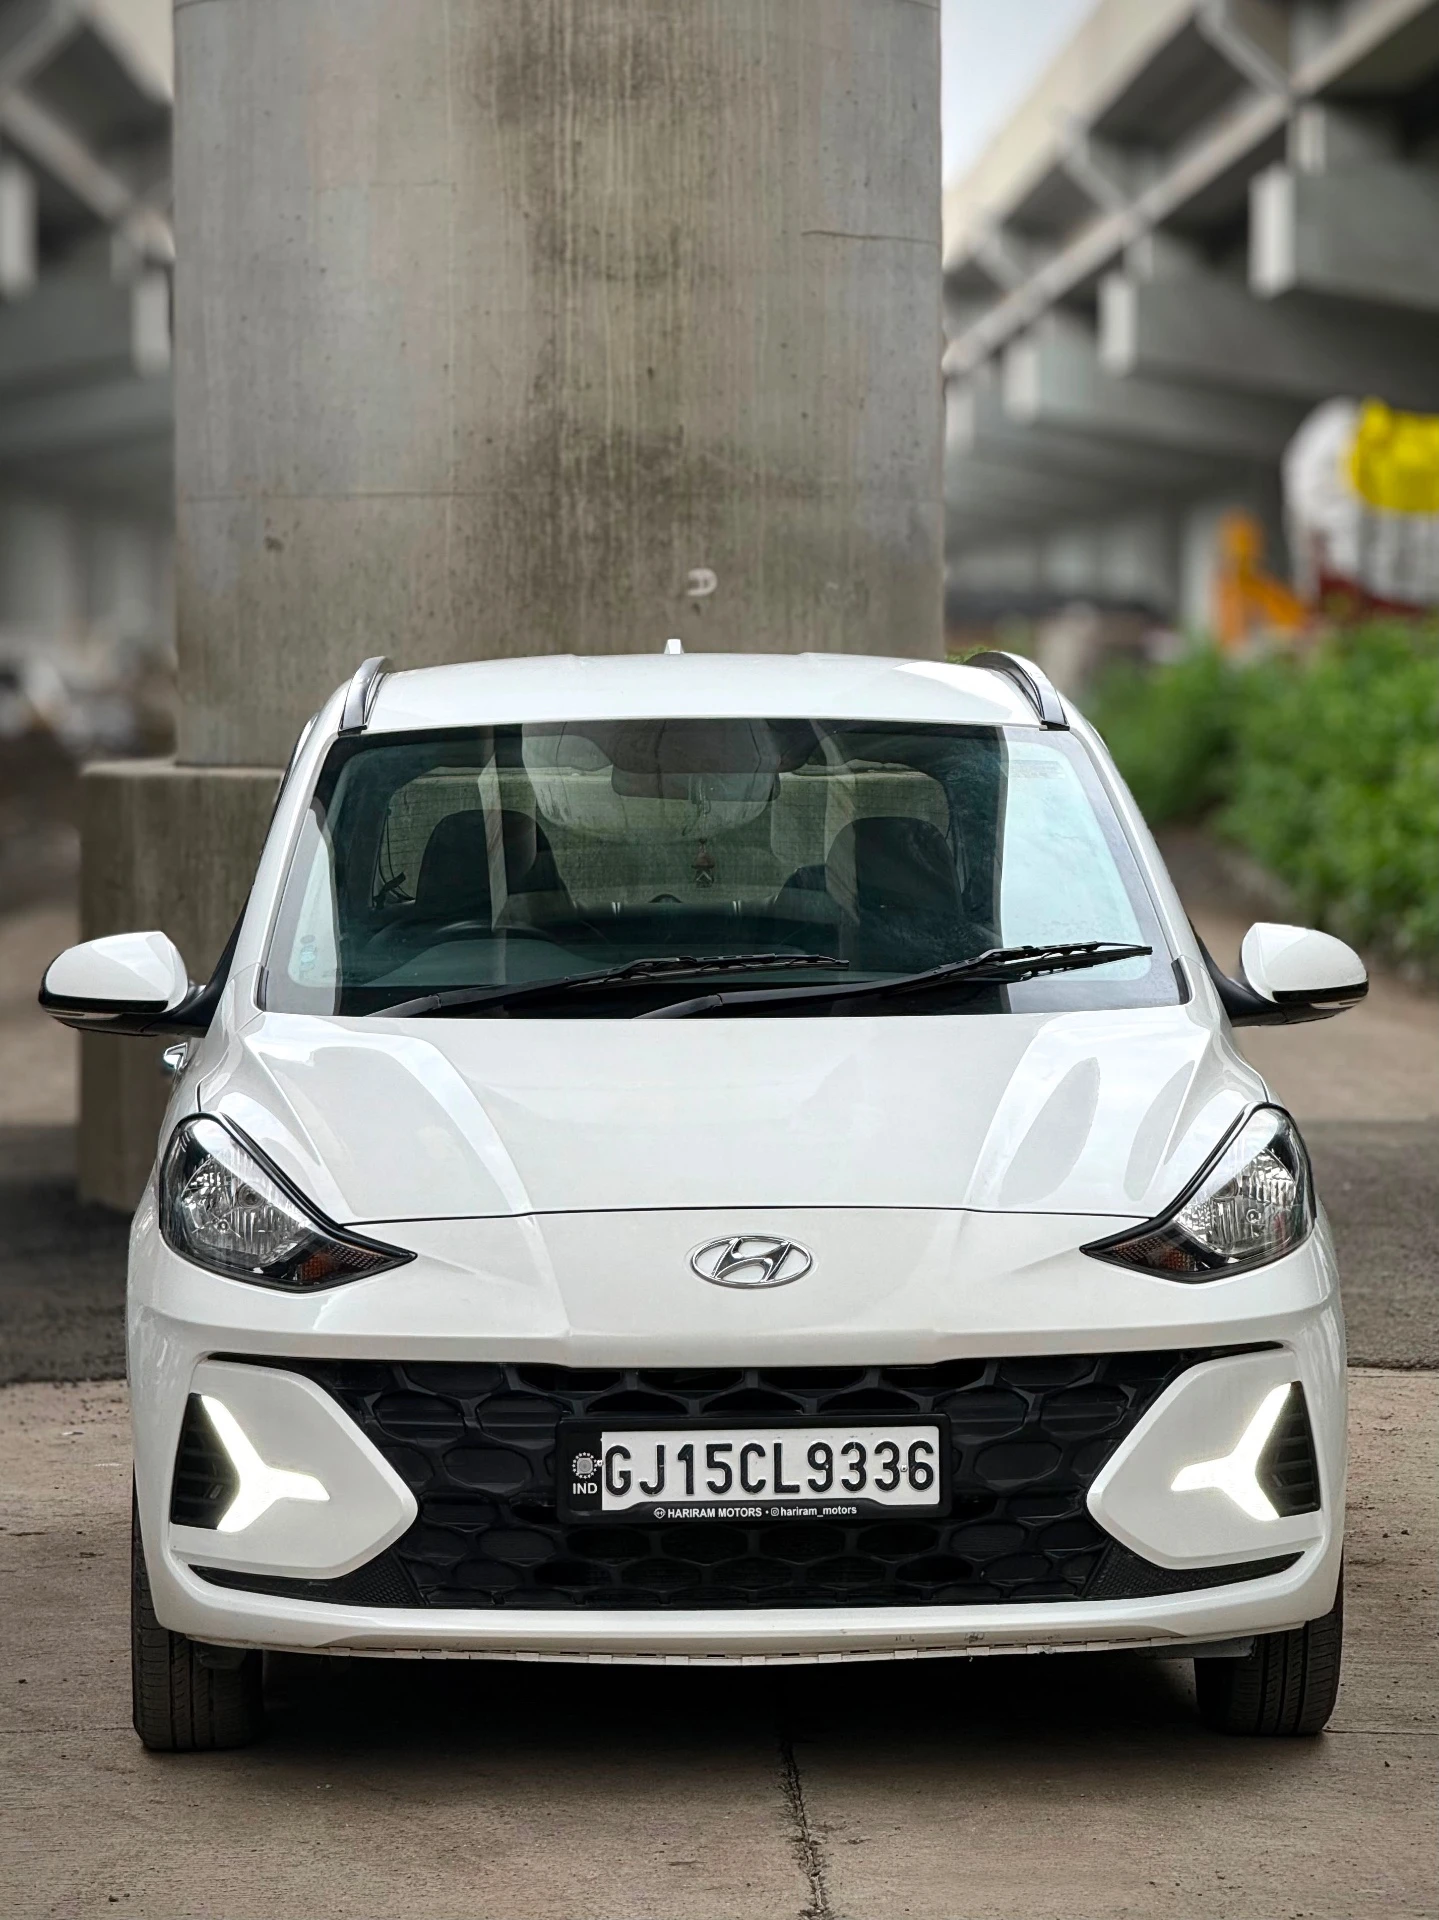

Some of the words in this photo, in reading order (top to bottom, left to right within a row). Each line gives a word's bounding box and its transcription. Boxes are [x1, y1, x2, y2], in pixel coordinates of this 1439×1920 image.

[605, 1439, 935, 1497] GJ15CL9336
[572, 1482, 598, 1495] IND
[667, 1507, 716, 1519] HARIRAM
[718, 1506, 763, 1519] MOTORS
